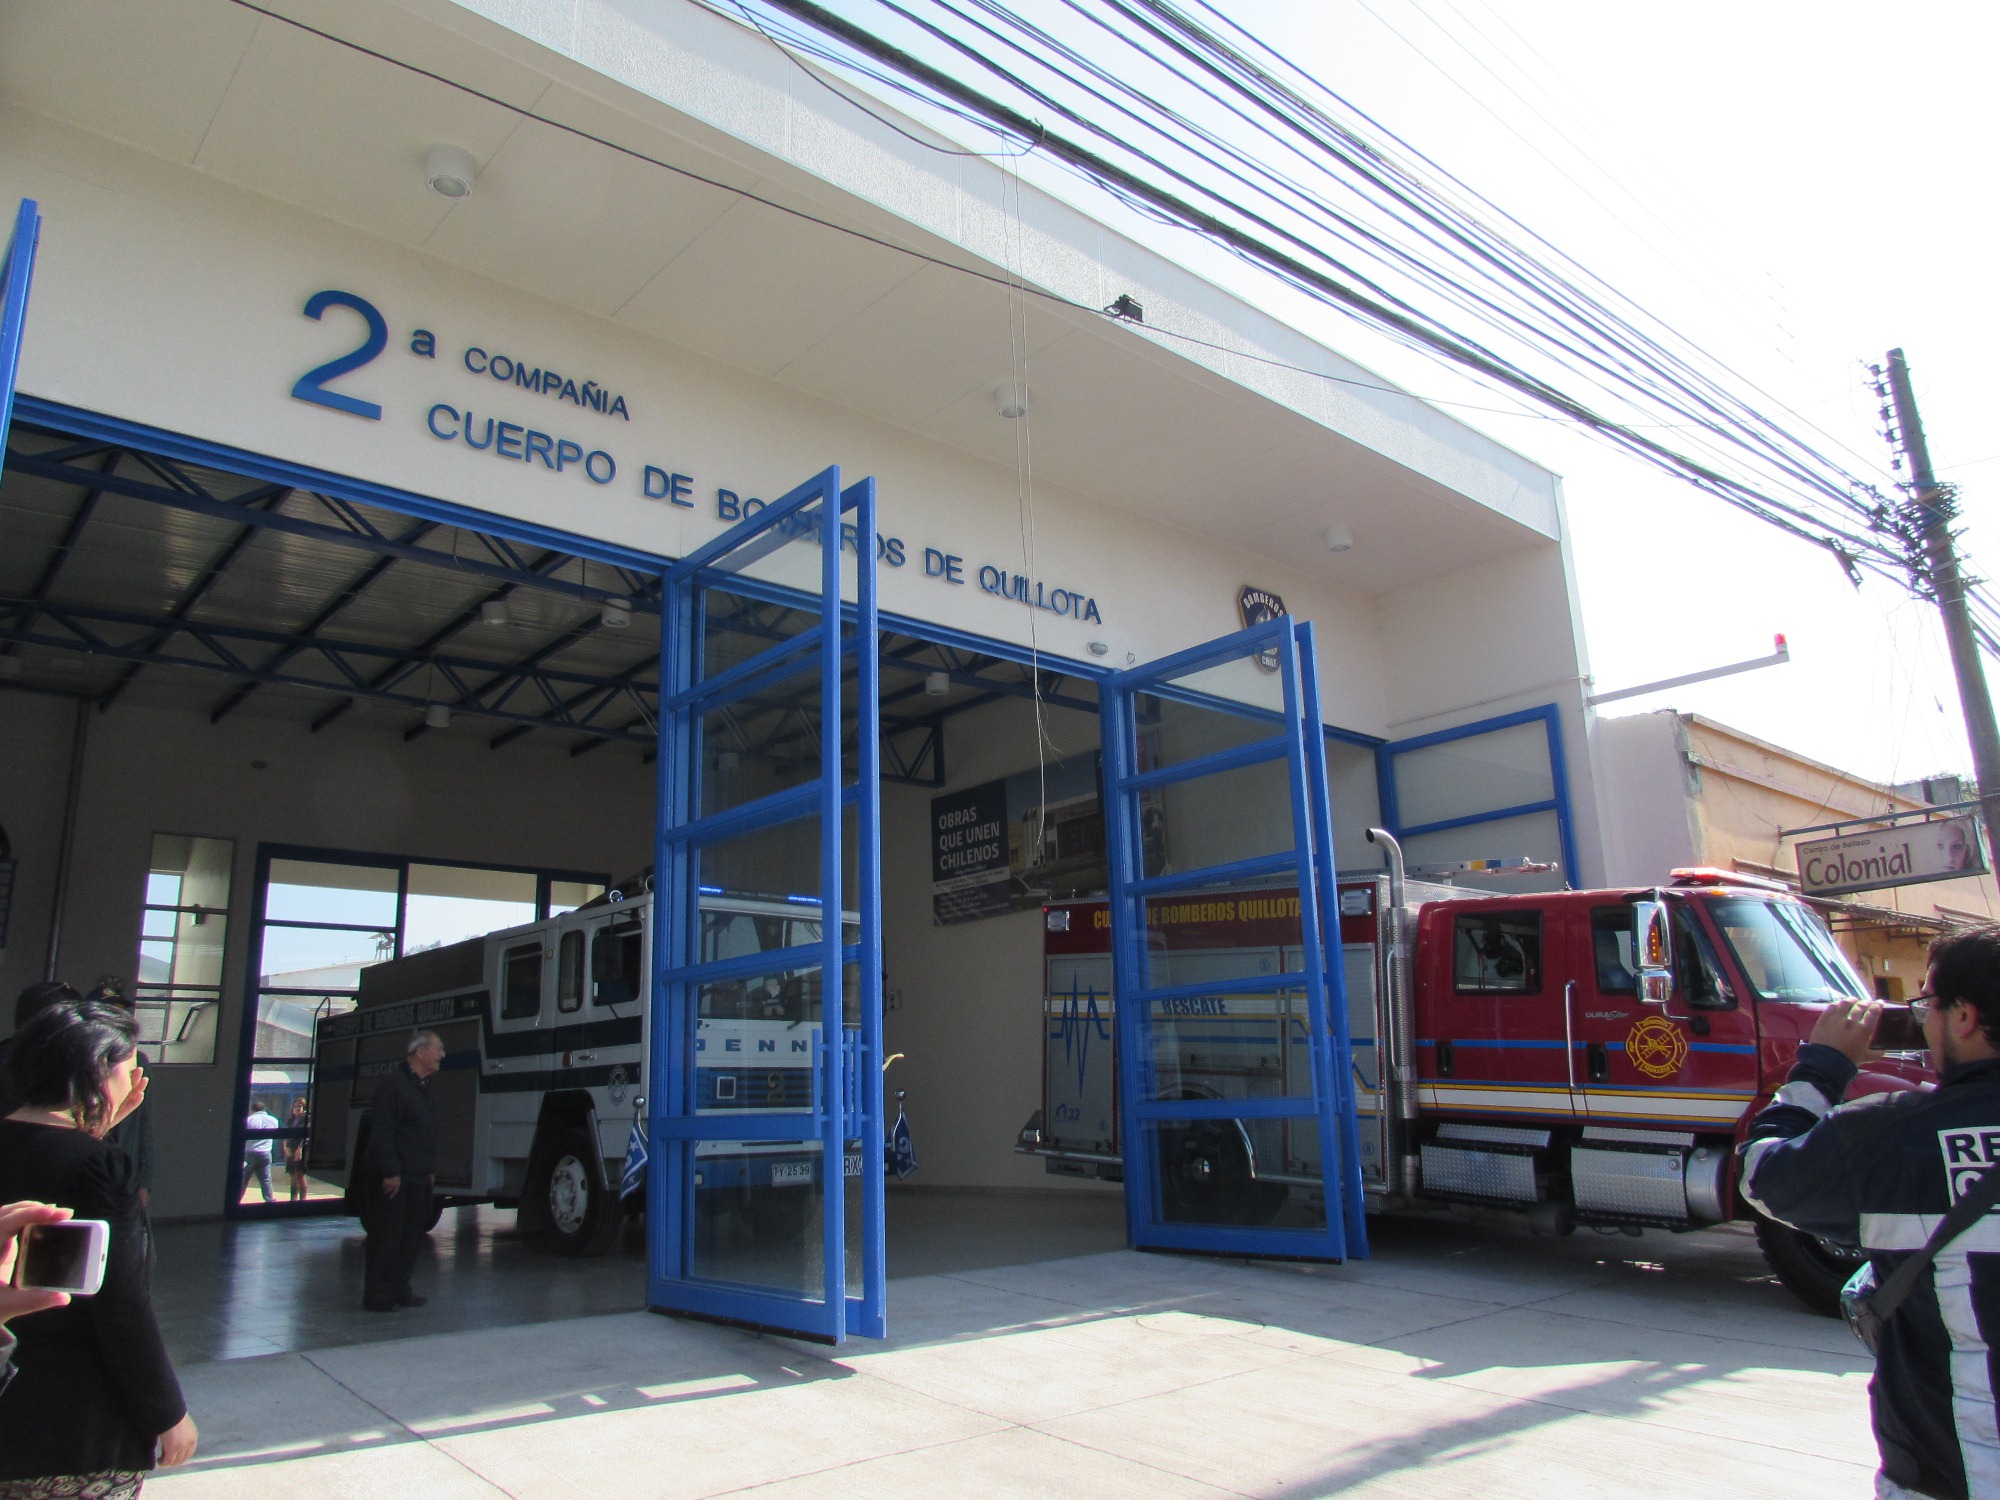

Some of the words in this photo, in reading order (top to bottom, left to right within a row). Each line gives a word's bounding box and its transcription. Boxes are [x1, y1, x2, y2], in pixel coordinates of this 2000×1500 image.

[464, 347, 630, 421] COMPAÑIA
[427, 403, 617, 485] CUERPO
[643, 464, 695, 508] DE
[924, 547, 964, 585] DE
[978, 565, 1103, 625] QUILLOTA
[938, 805, 977, 830] OBRAS
[939, 829, 964, 852] QUE
[966, 821, 1000, 843] UNEN
[940, 842, 1000, 870] CHILENOS
[1806, 843, 1912, 886] Colonial
[1161, 901, 1235, 925] BOMBEROS
[1161, 998, 1228, 1016] RESCATE
[361, 1060, 400, 1077] RESCAT
[766, 1071, 785, 1104] 2
